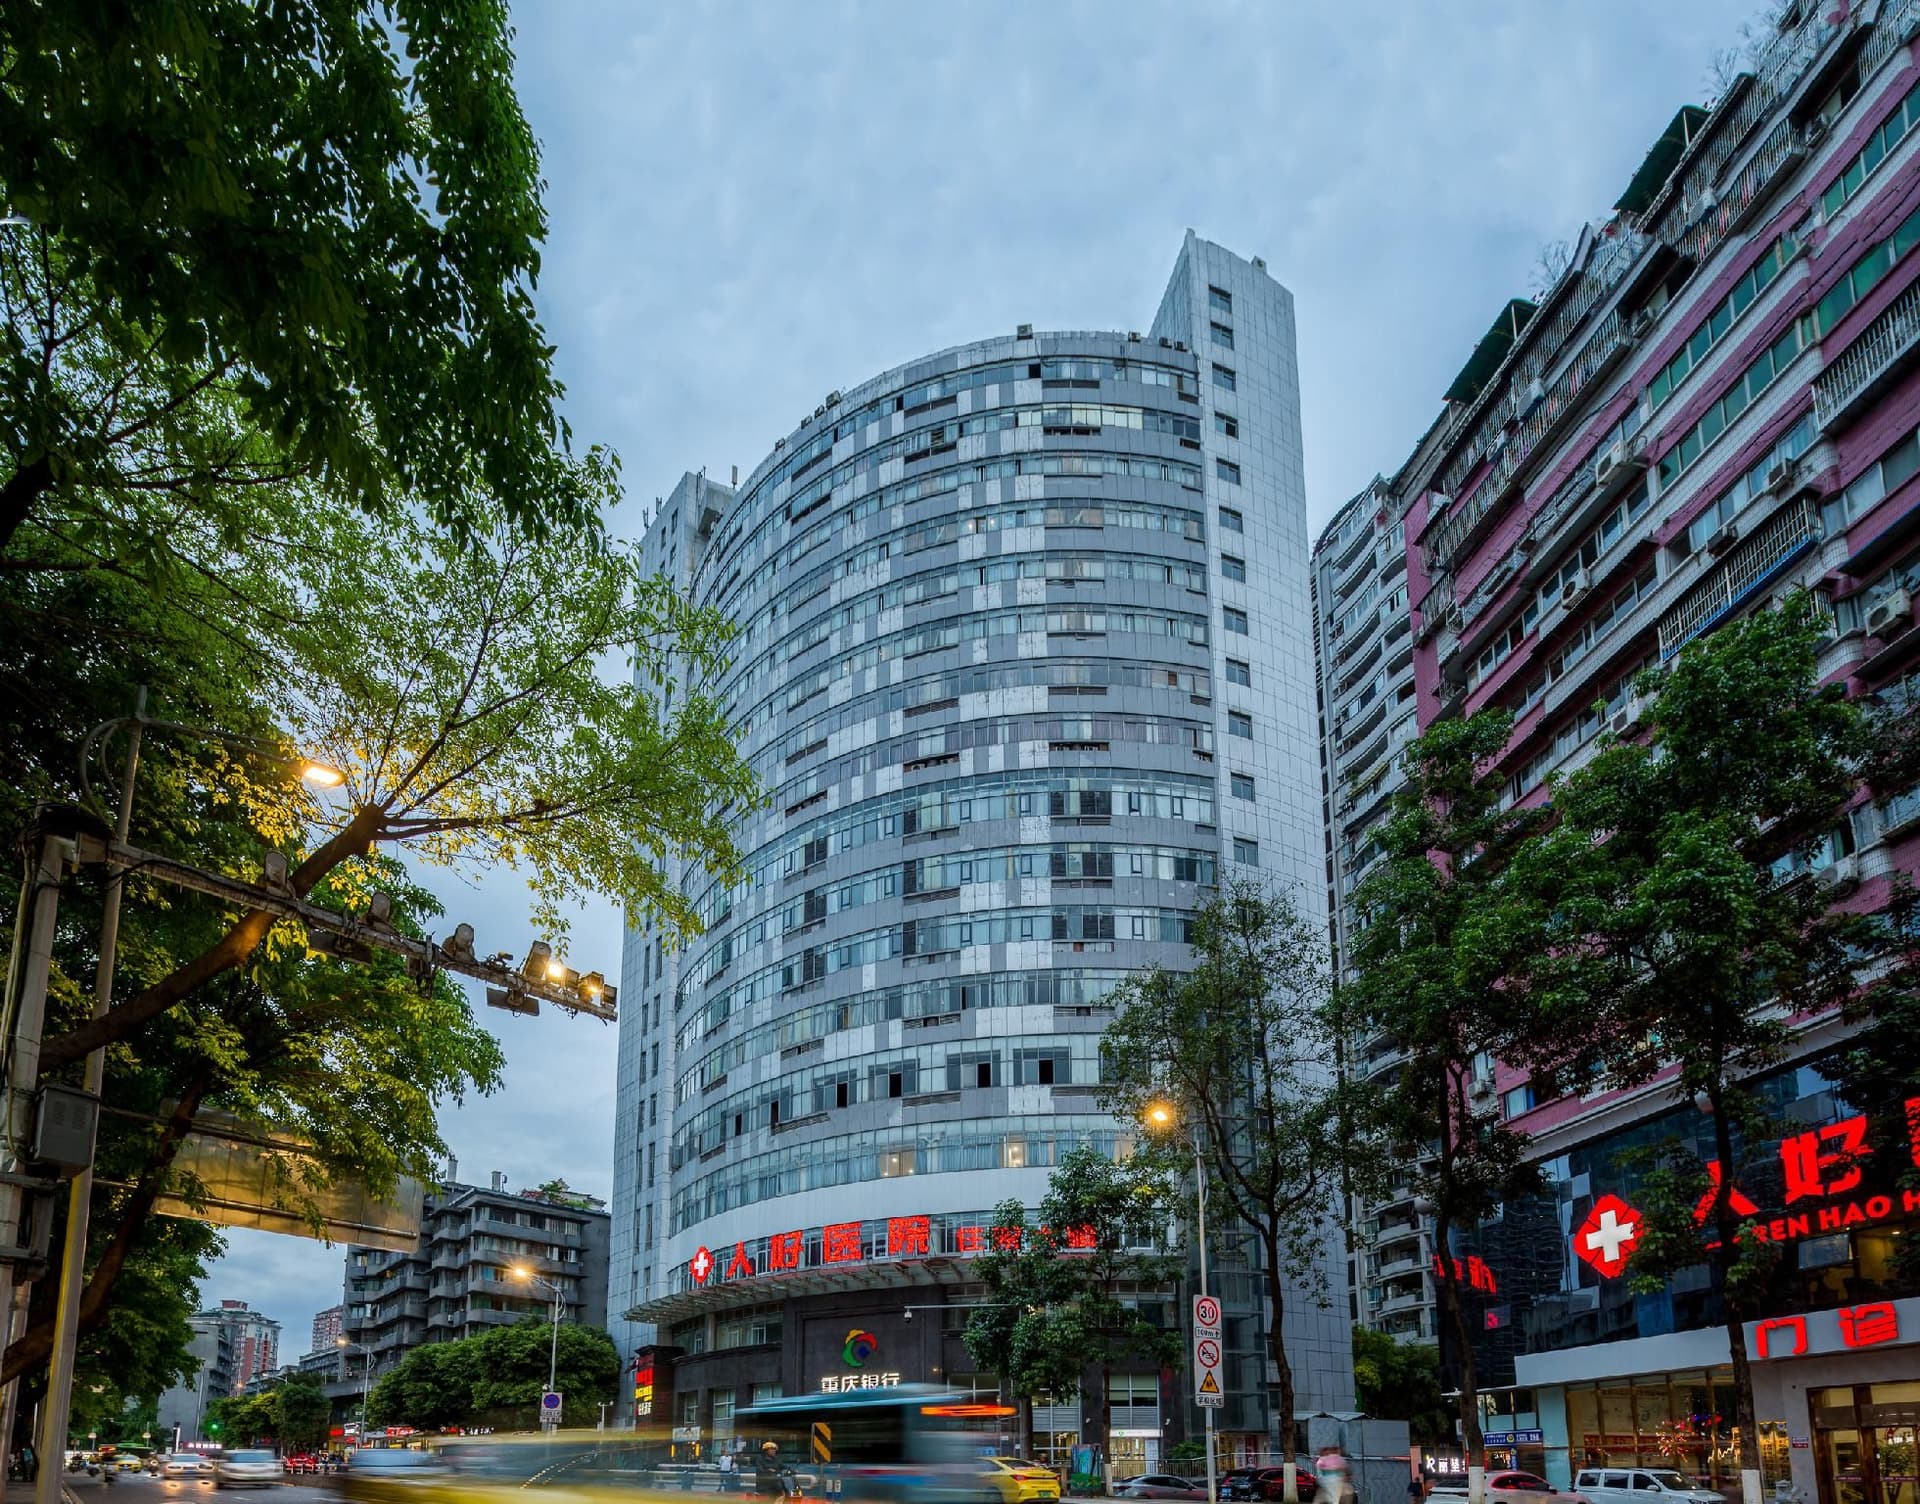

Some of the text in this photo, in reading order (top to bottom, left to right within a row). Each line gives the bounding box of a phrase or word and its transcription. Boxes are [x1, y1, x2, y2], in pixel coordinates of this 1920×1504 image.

[1818, 1195, 1891, 1231] HAO
[726, 1214, 931, 1279] 人好医院
[1200, 1305, 1215, 1319] 30
[1755, 1302, 1899, 1359] 门诊
[820, 1372, 900, 1394] 重庆银行
